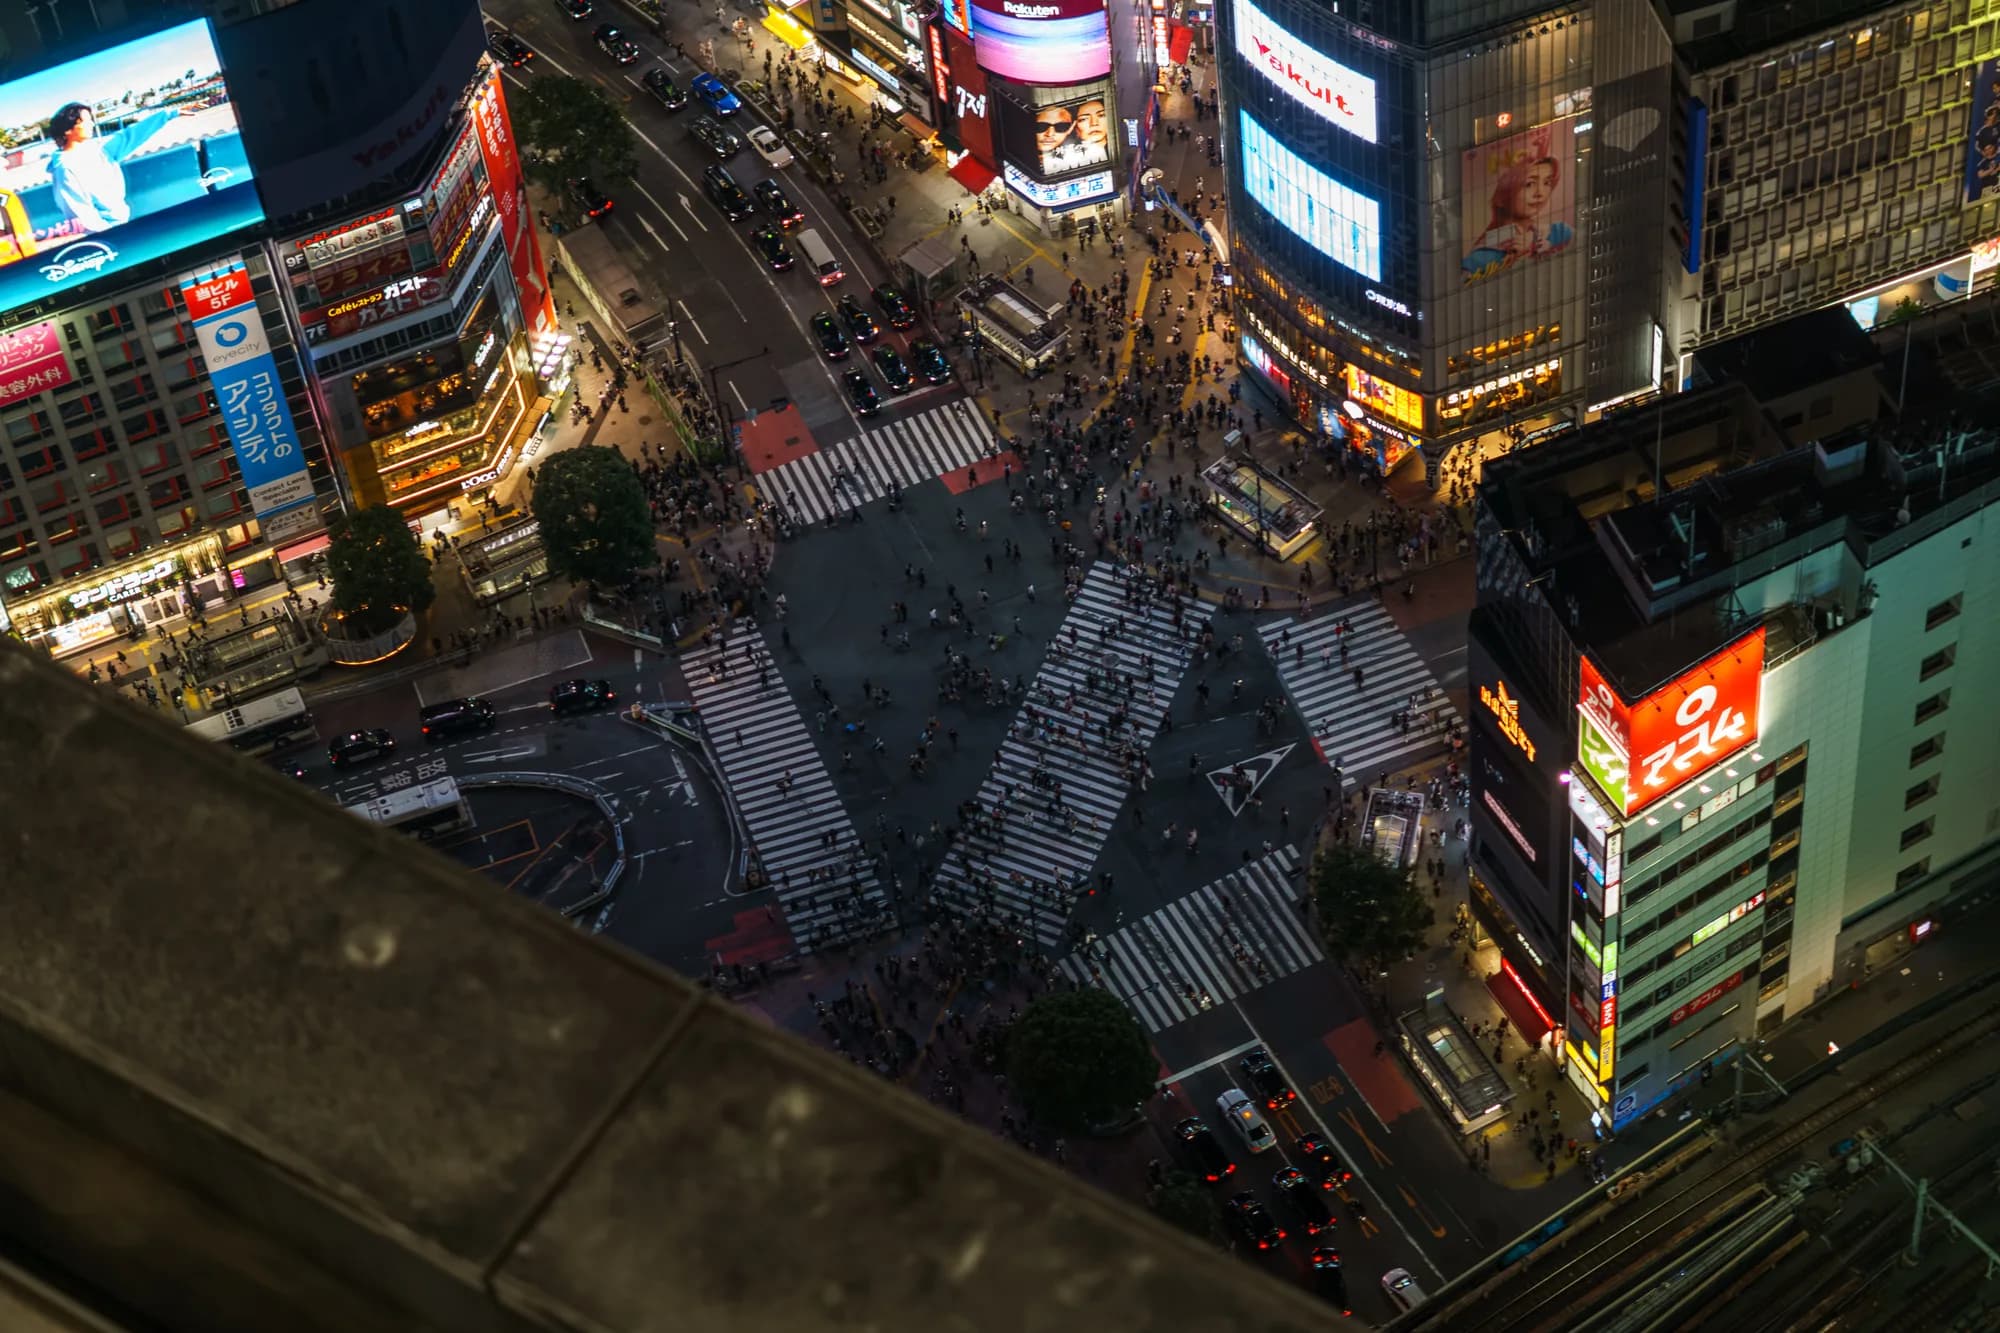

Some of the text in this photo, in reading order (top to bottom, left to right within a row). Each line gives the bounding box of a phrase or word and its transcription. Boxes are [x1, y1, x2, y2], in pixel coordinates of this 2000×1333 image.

[1004, 1, 1060, 17] Rakuten
[1252, 35, 1354, 117] Yakult
[286, 253, 304, 269] 9F
[195, 278, 239, 301] 当ビル
[383, 276, 428, 300] ガスト
[210, 293, 231, 310] 5F
[306, 323, 327, 340] 7F
[212, 336, 261, 361] eyecity
[1249, 311, 1329, 386] STARBUCKS
[1447, 359, 1559, 404] STARBUCKS
[222, 379, 268, 465] アイシティ
[252, 371, 293, 459] コンタクトの
[1366, 417, 1404, 440] TSUTAYA
[1642, 705, 1747, 787] アコム
